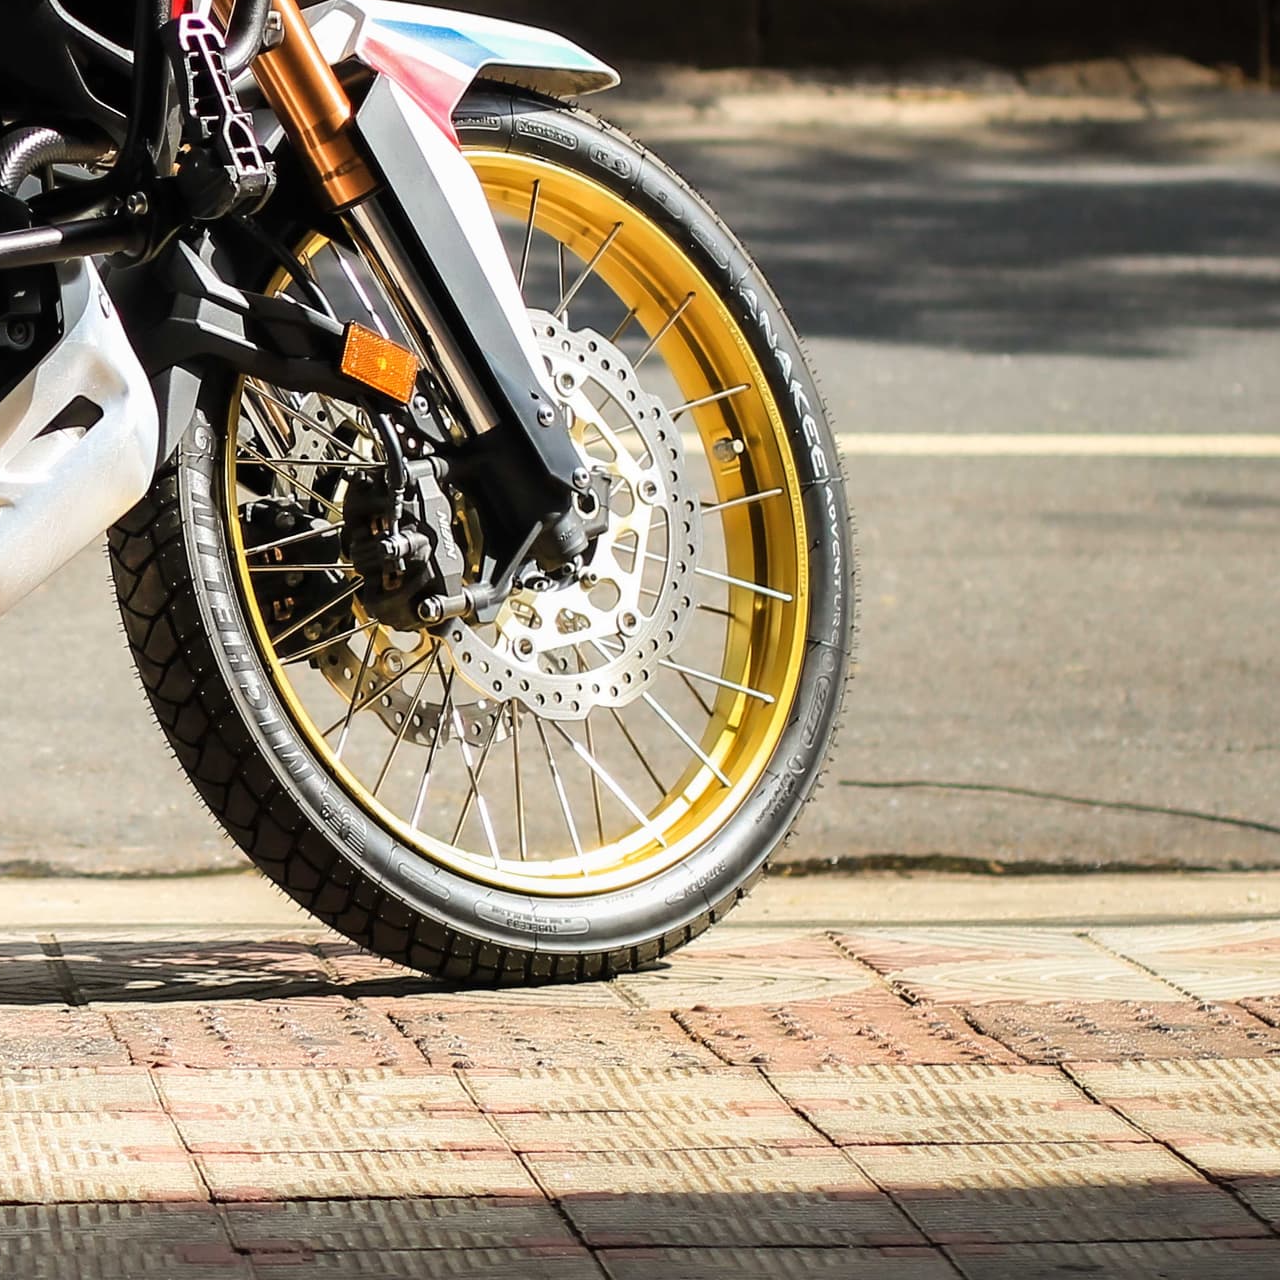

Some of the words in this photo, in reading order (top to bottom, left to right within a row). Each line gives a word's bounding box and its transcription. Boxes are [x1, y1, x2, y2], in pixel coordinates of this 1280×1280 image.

[739, 285, 828, 479] ANAKEE
[823, 484, 842, 648] ADVENTURE
[190, 493, 317, 785] MICHELIN
